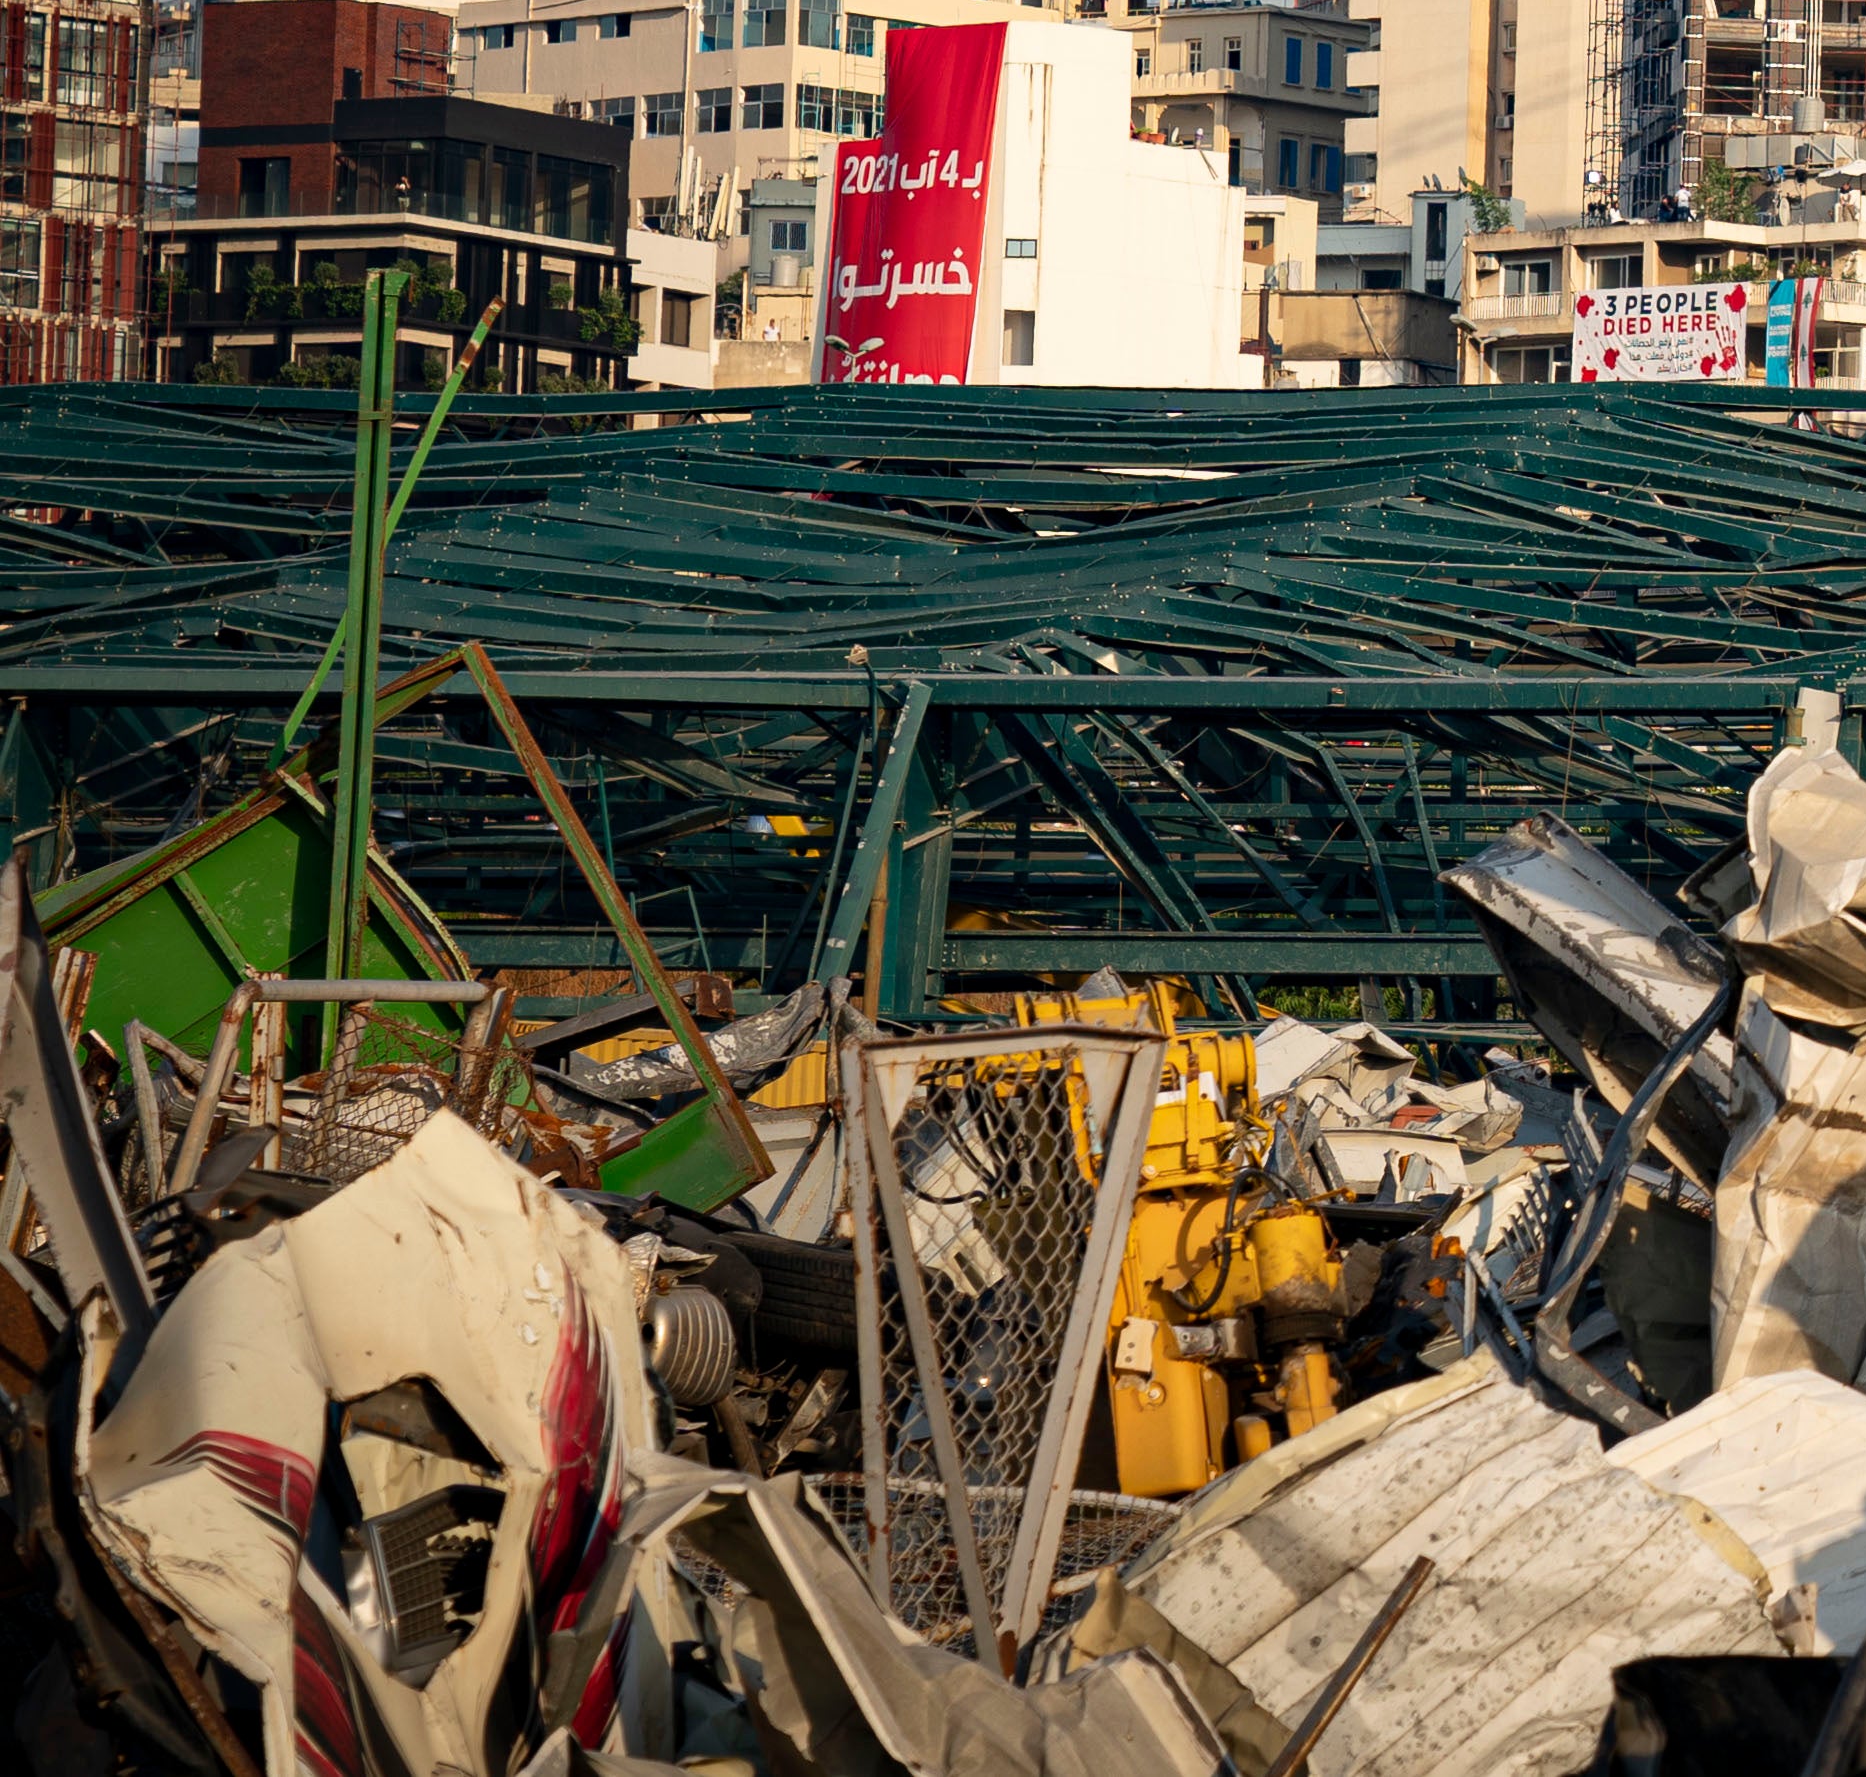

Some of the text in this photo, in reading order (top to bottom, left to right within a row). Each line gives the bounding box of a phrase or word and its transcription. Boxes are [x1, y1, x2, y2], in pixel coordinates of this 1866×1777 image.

[840, 152, 899, 195] 2021
[939, 149, 960, 189] 4
[1604, 291, 1718, 316] 3 PEOPLE
[1603, 313, 1717, 336] DIED HERE
